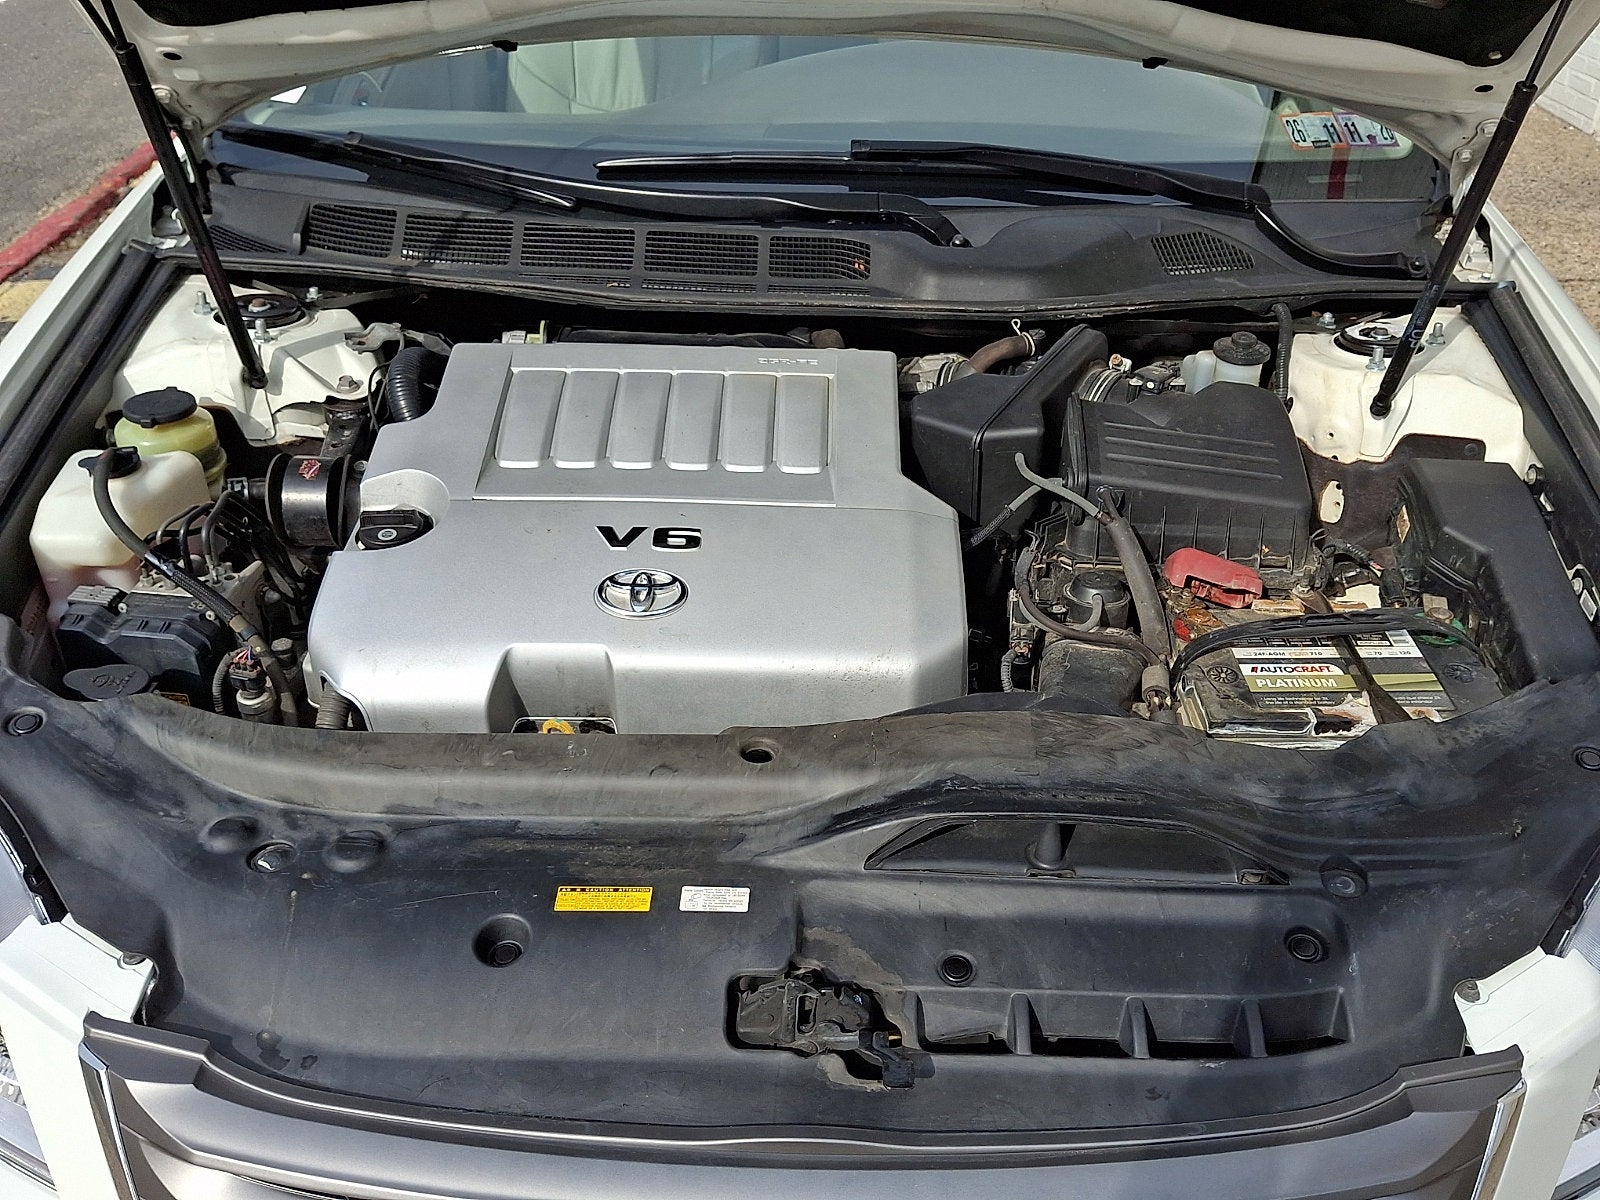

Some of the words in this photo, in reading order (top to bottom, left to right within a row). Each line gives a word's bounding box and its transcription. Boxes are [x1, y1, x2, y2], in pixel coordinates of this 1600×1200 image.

[1285, 119, 1307, 143] 26
[1322, 122, 1343, 143] 11
[1343, 121, 1364, 143] 11
[595, 525, 703, 552] V6
[1259, 665, 1332, 674] AUTOCRAFT
[1256, 678, 1338, 688] PLATINUM
